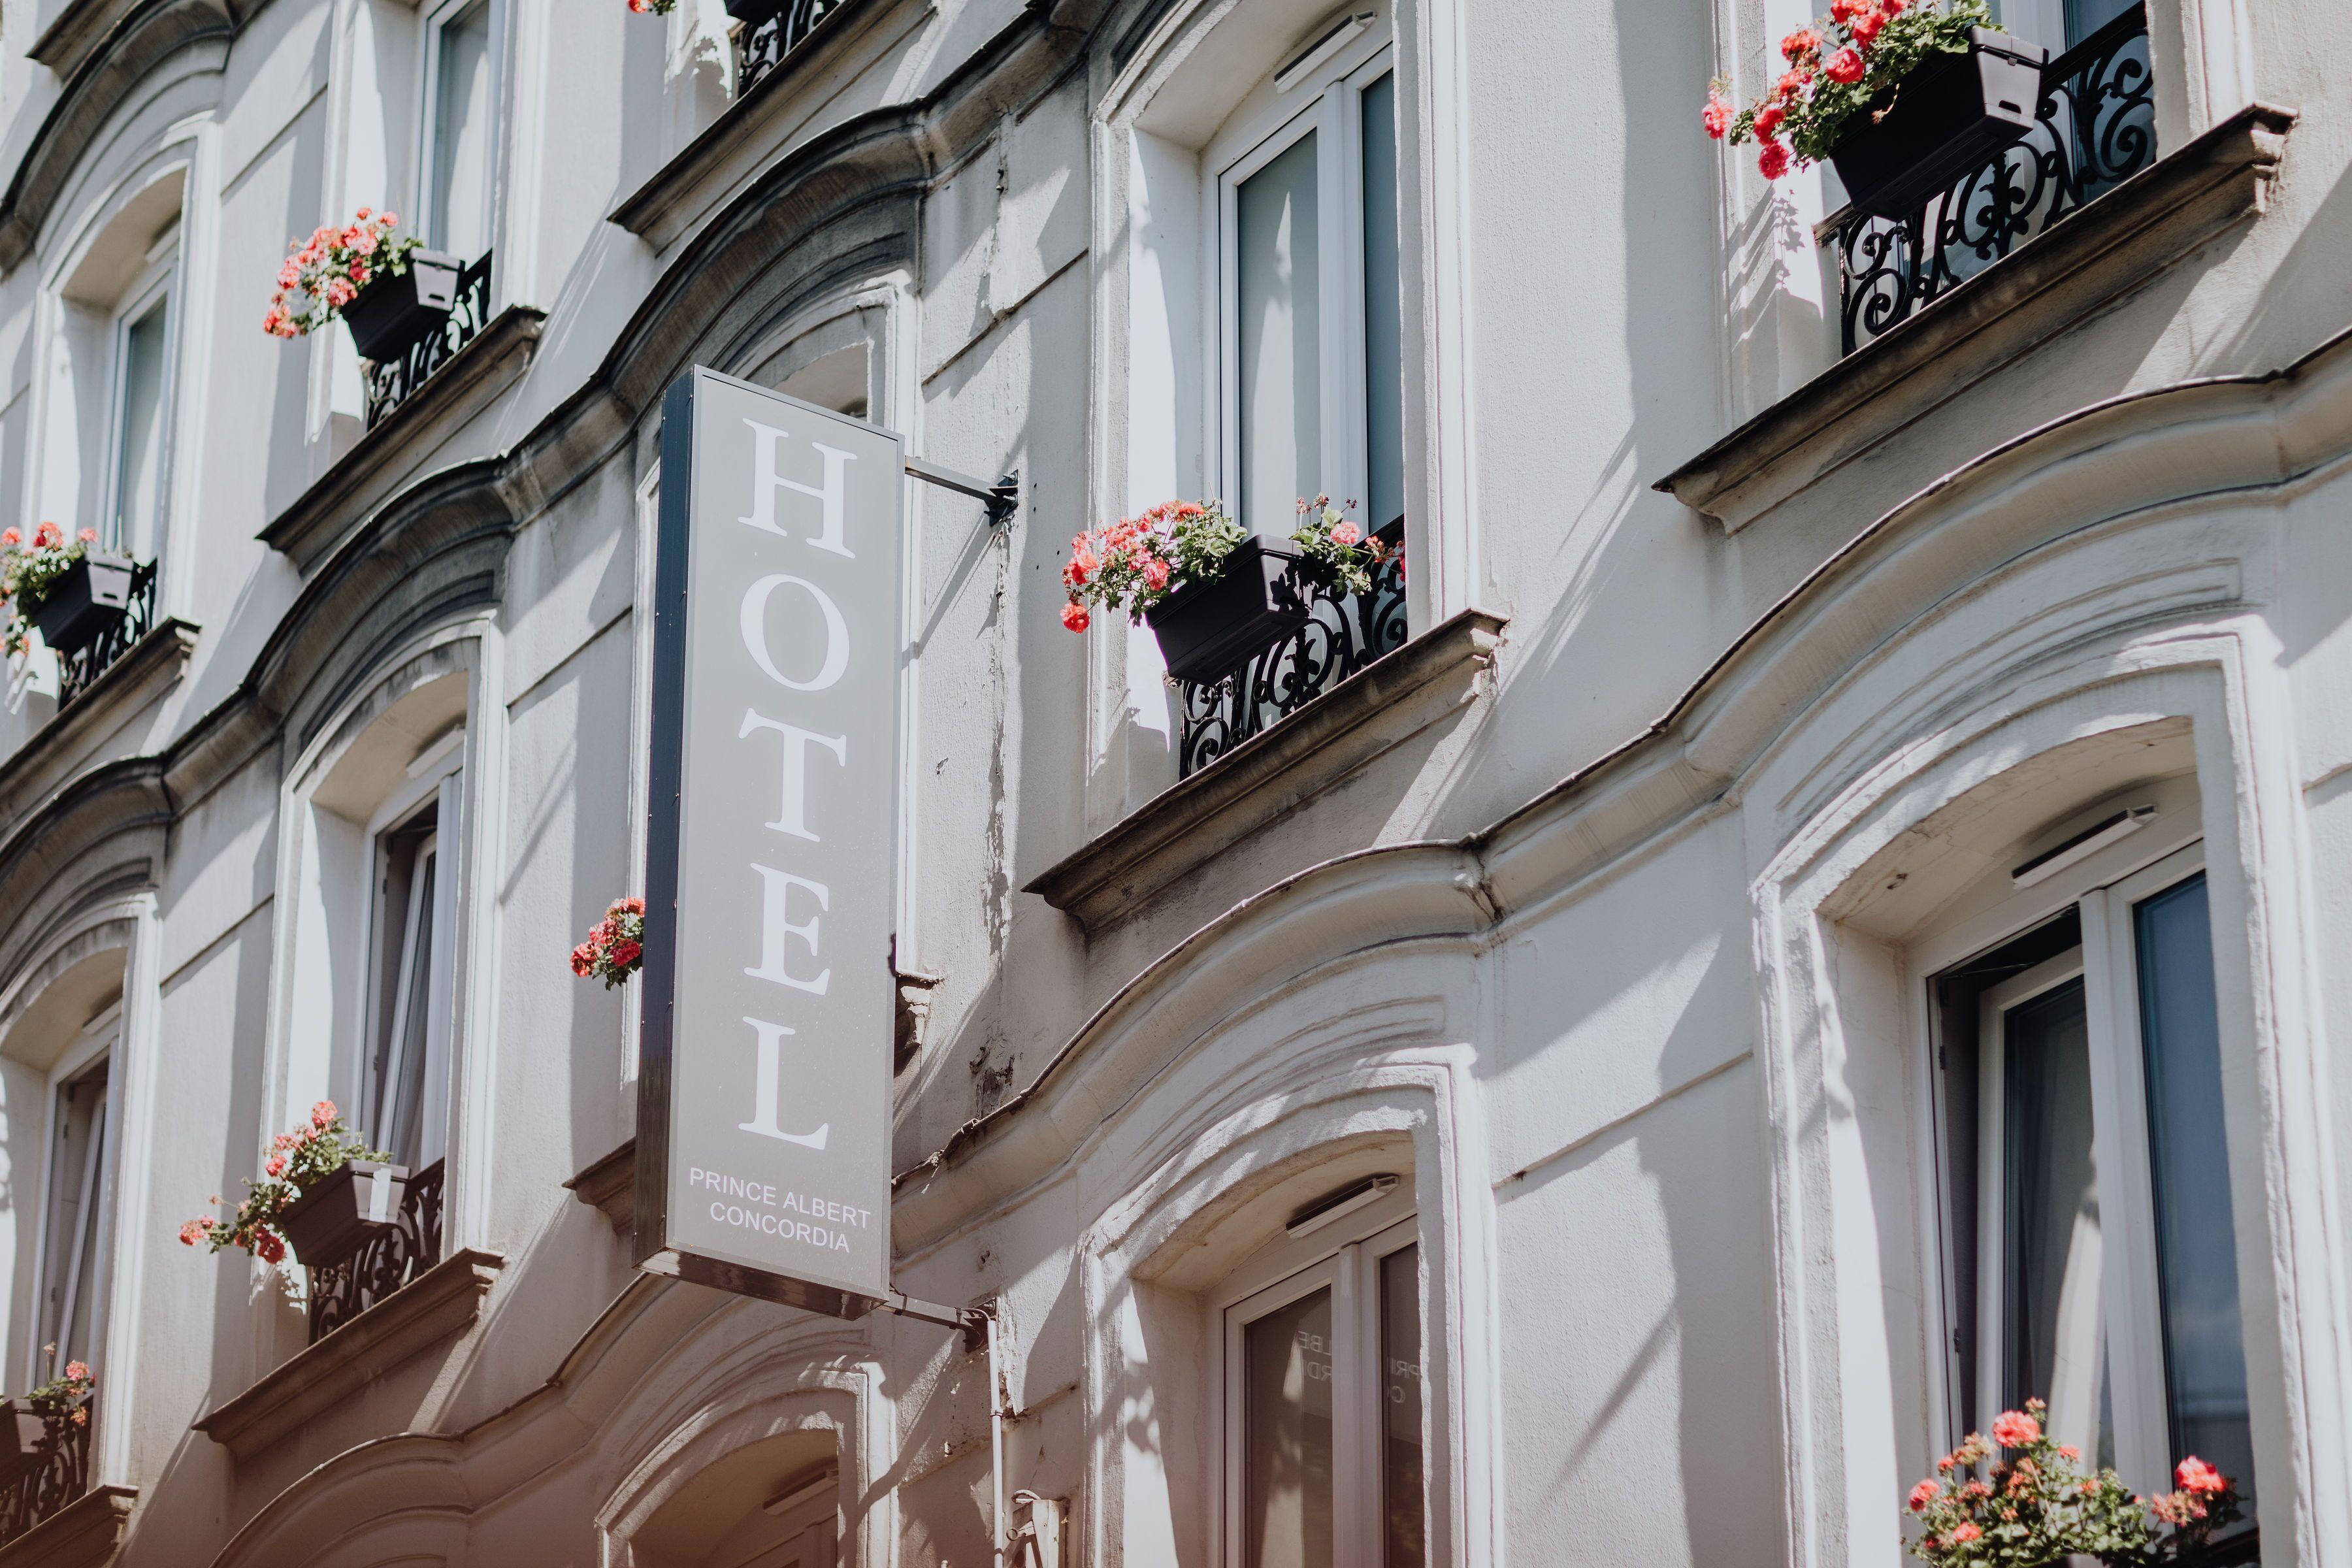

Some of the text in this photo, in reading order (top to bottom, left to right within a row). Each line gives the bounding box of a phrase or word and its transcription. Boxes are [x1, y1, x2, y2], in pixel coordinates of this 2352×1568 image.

[738, 418, 858, 1151] HOTEL
[690, 1168, 871, 1229] PRINCE ALBERT
[710, 1202, 849, 1253] CONCORDIA
